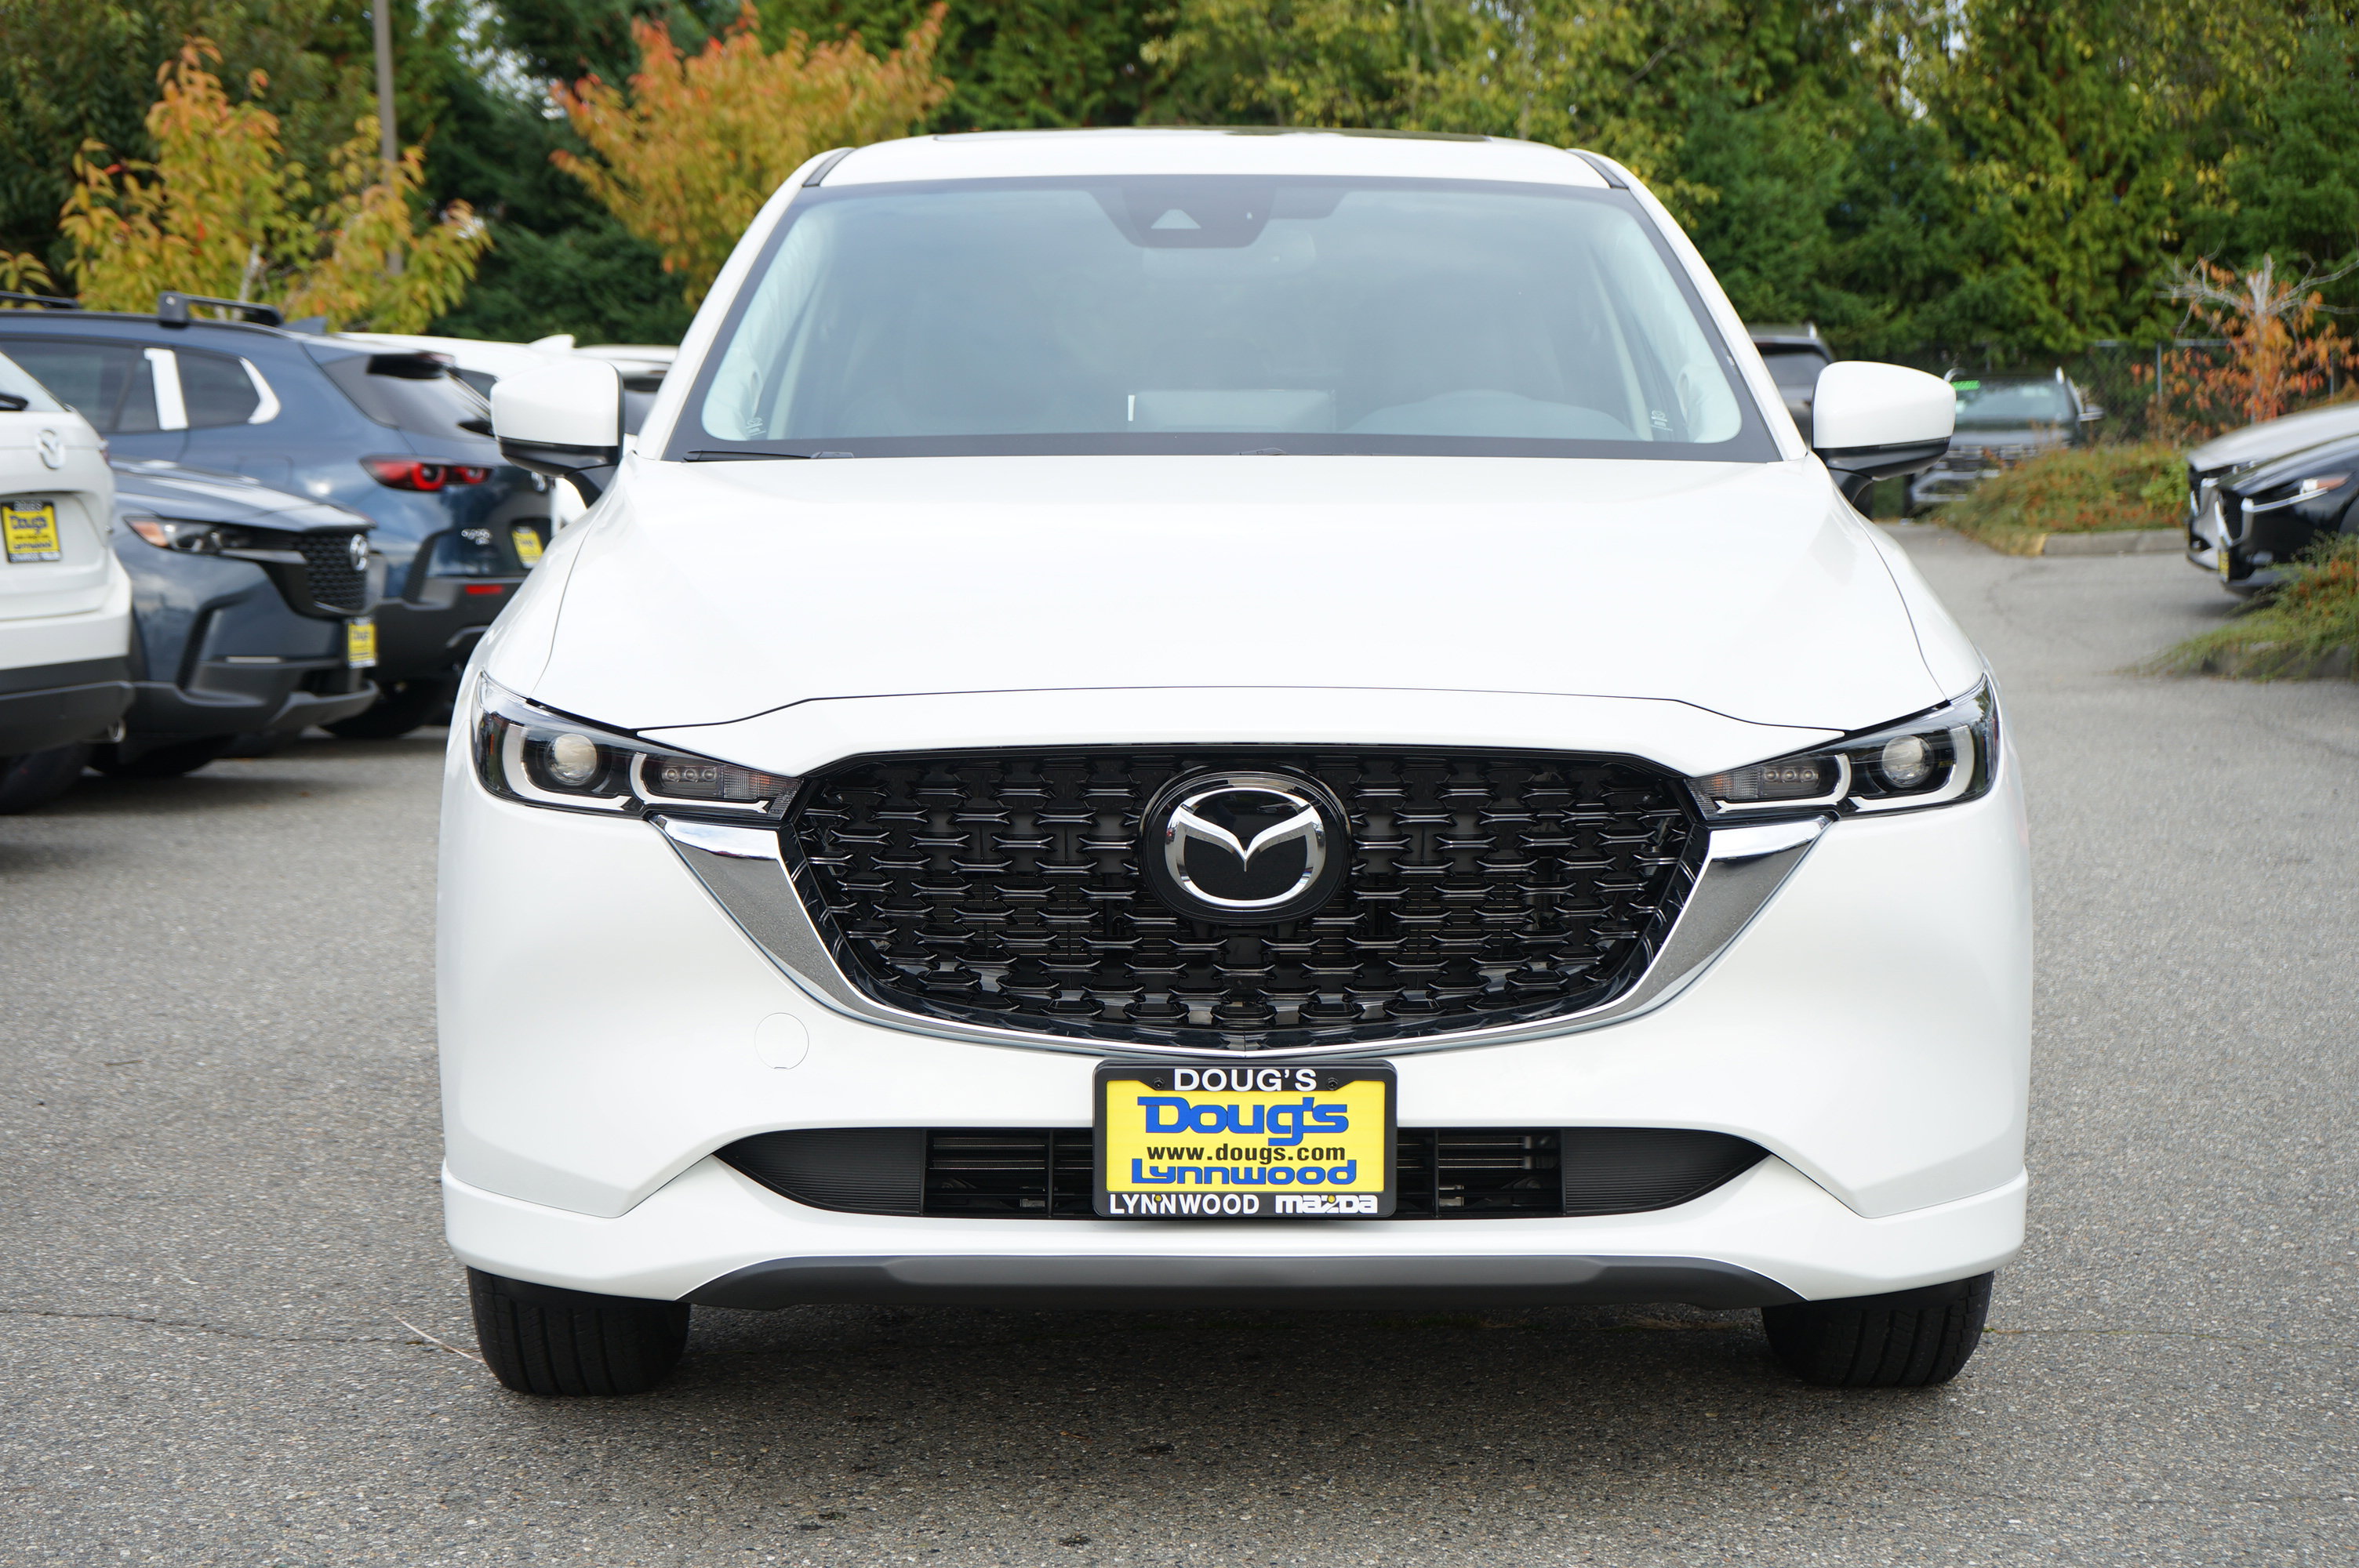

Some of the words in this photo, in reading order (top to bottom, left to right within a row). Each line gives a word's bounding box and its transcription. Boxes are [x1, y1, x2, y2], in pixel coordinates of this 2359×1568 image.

[1174, 1069, 1317, 1092] DOUG'S
[1137, 1097, 1349, 1146] Doug's
[1147, 1144, 1346, 1164] www.dougs.com
[1131, 1159, 1357, 1185] Lynnwood
[1109, 1194, 1259, 1214] LYNNWOOD
